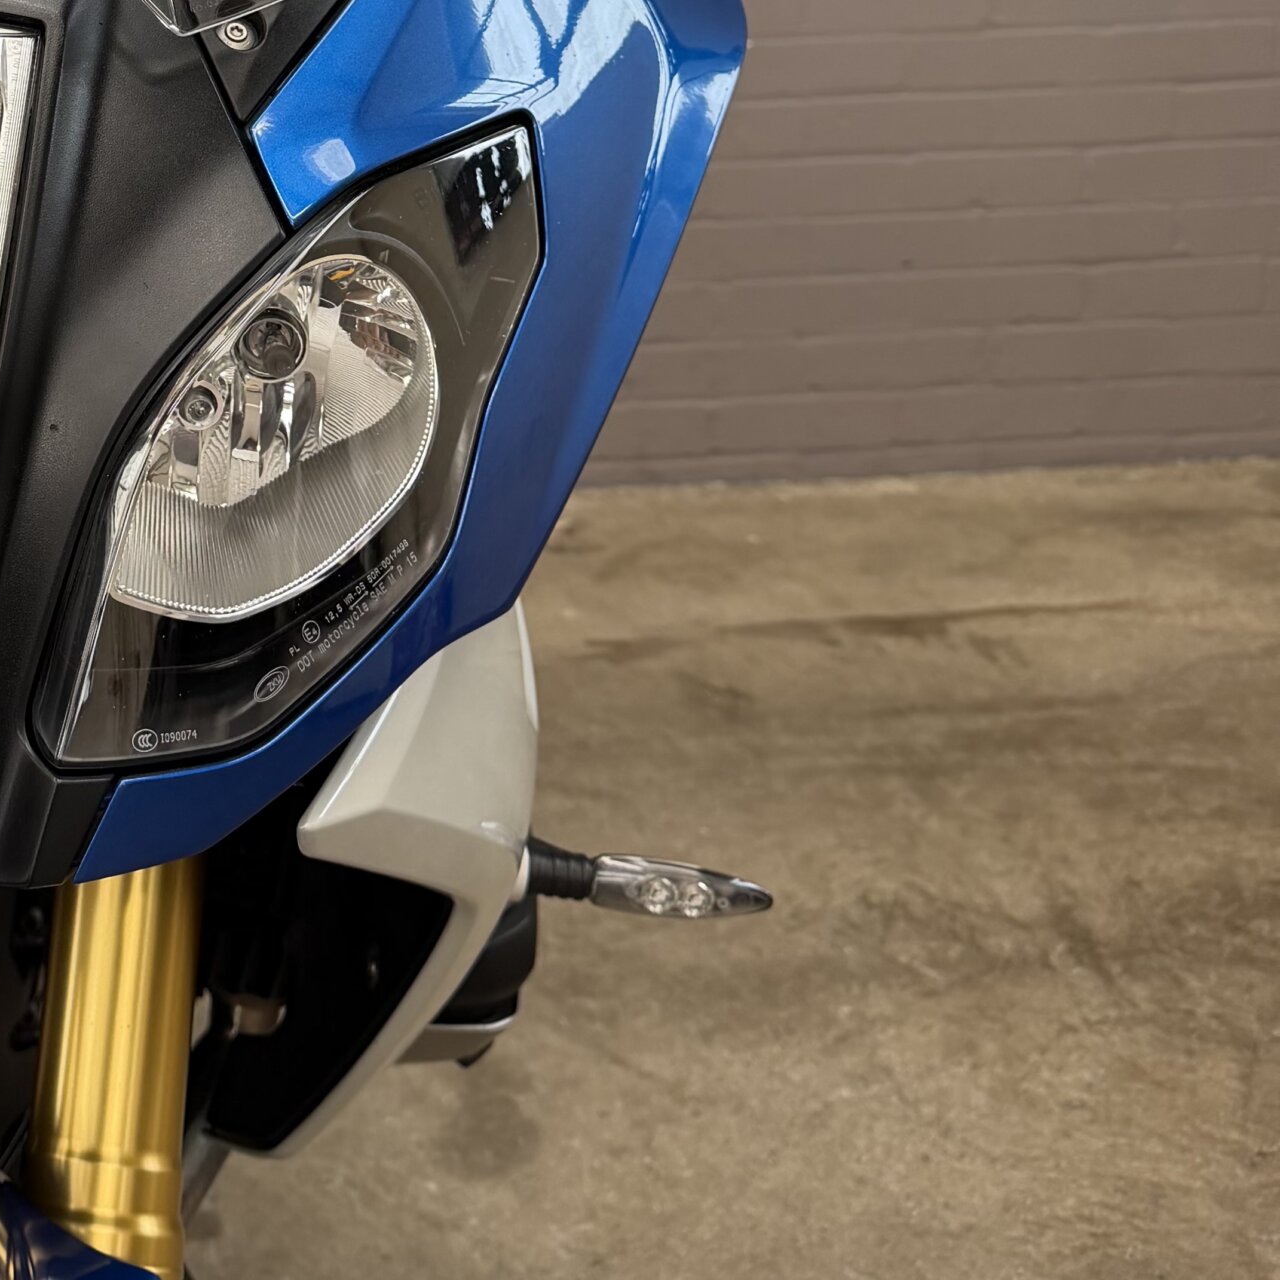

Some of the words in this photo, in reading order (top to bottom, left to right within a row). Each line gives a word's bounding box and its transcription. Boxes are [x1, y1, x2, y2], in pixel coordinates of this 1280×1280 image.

[288, 644, 301, 657] PL
[324, 603, 343, 623] 12,5
[297, 650, 316, 672] DOT
[317, 602, 370, 654] motorcycle
[369, 582, 388, 601] SAE
[396, 565, 403, 576] P
[406, 551, 418, 567] 15
